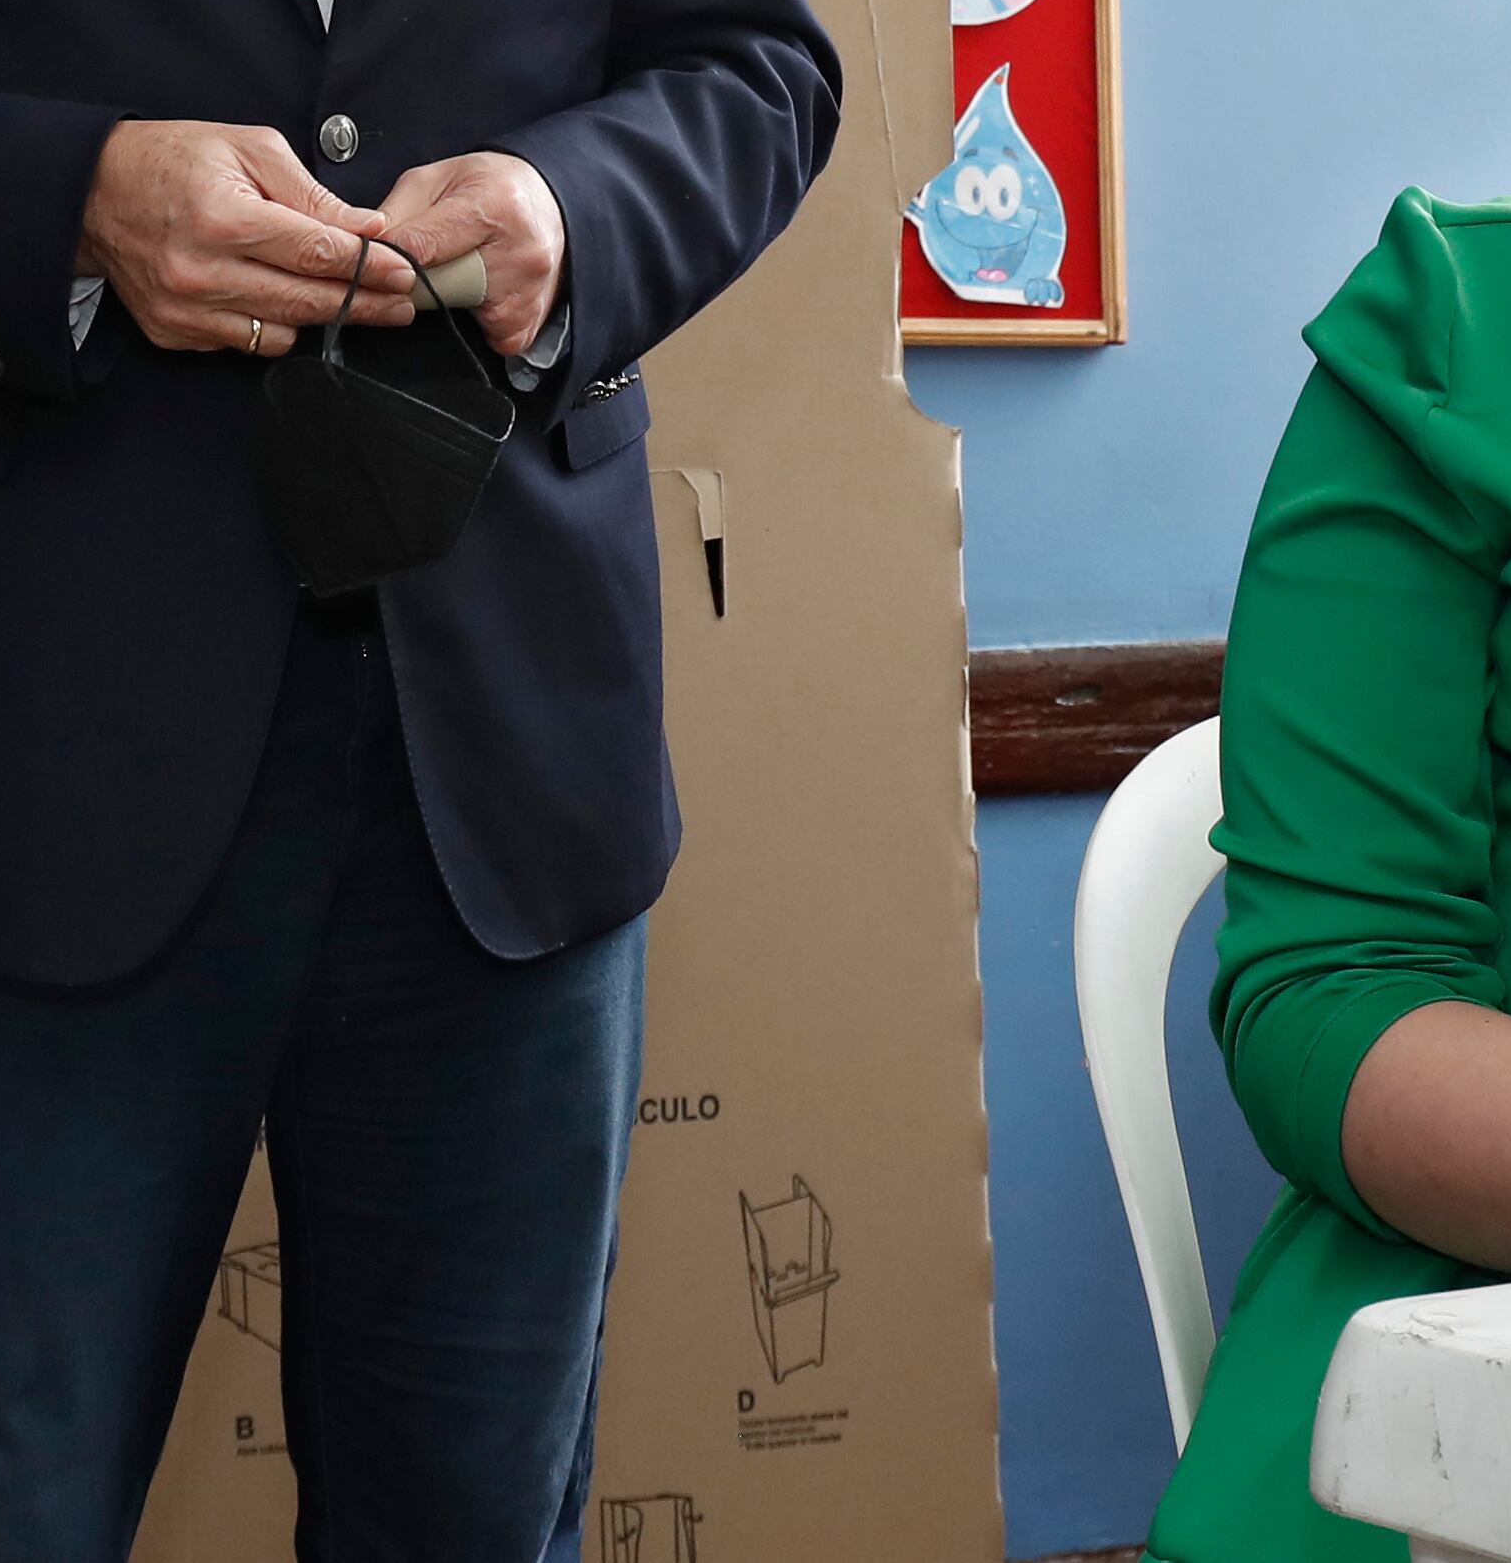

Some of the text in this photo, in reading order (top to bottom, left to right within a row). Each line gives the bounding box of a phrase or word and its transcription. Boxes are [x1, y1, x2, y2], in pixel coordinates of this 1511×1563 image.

[634, 1093, 721, 1125] CULO
[738, 1390, 755, 1413] D
[236, 1415, 254, 1440] B
